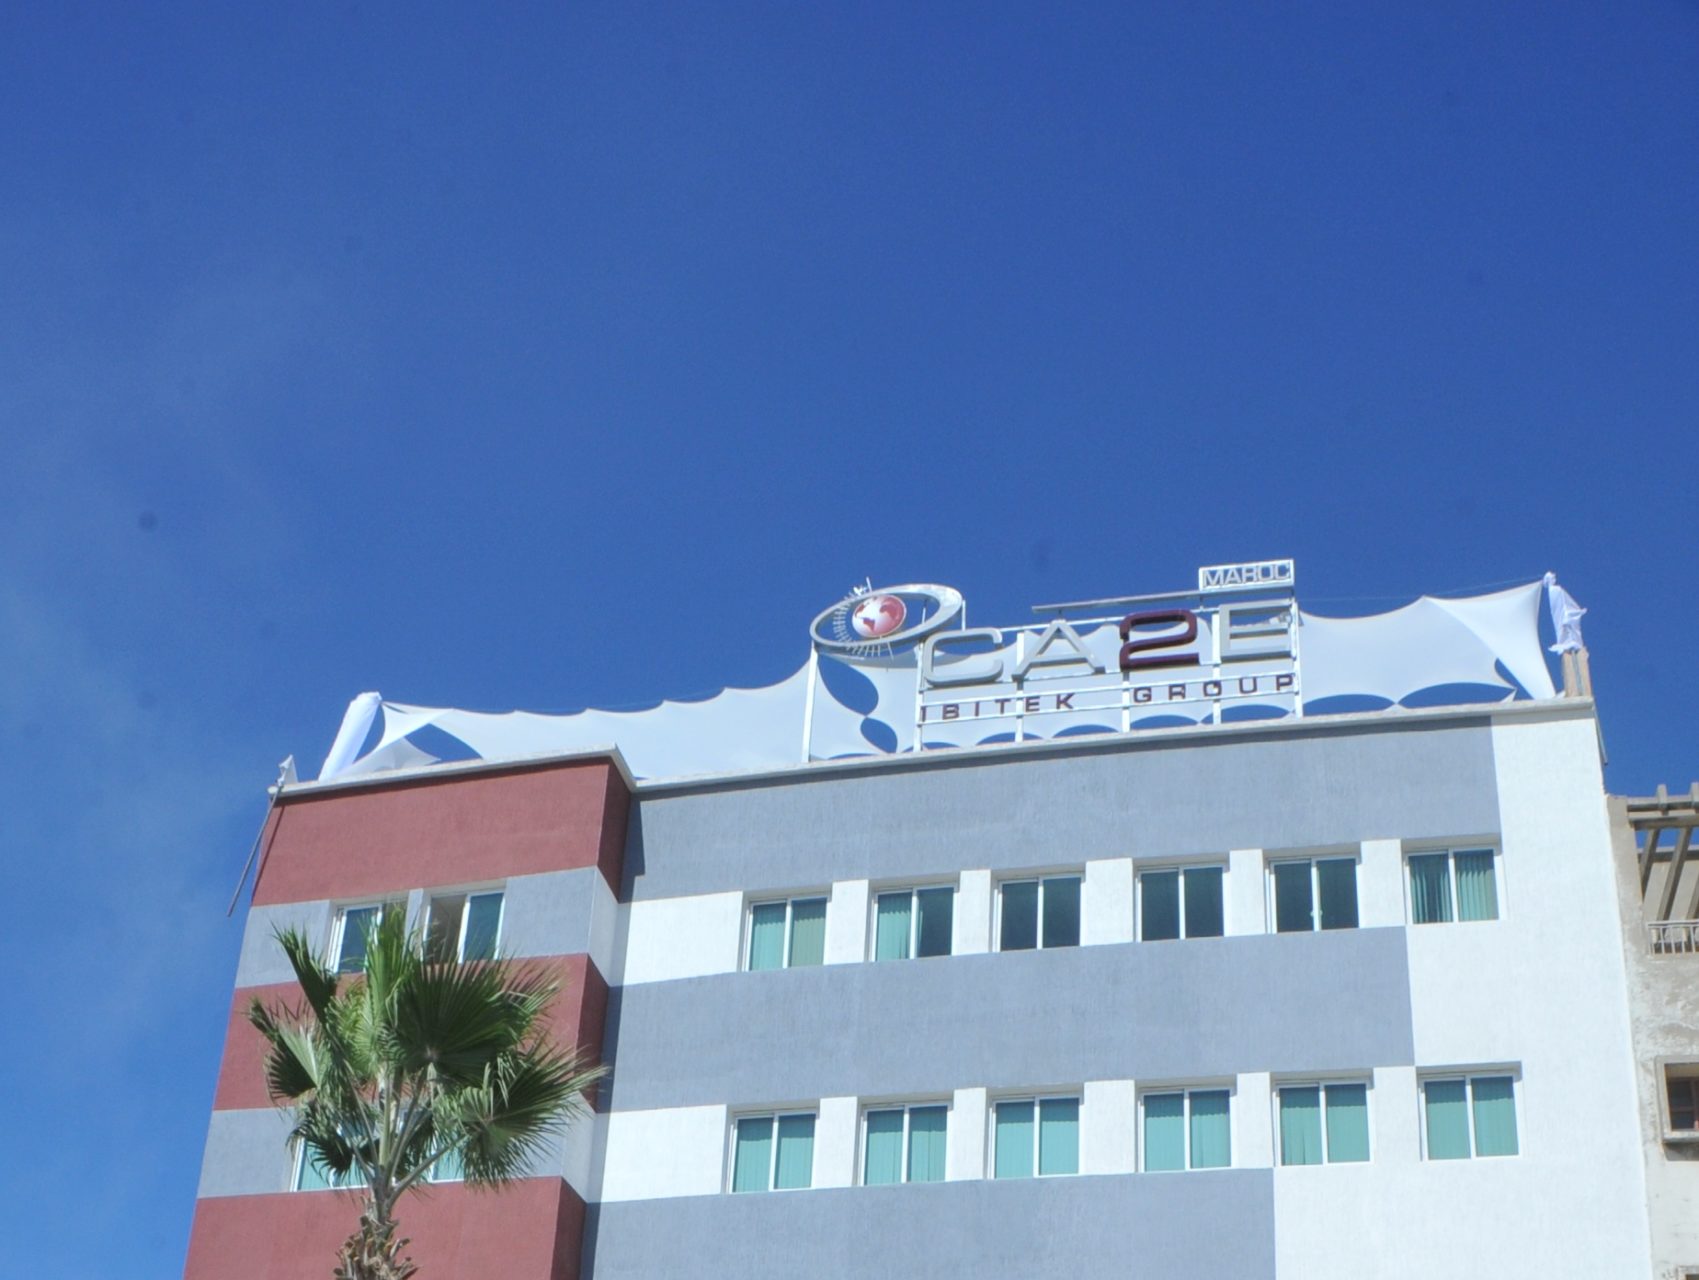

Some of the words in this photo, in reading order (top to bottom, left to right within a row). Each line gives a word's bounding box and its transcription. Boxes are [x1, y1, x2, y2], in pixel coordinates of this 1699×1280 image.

[1203, 564, 1291, 587] MAROC
[923, 600, 1293, 688] CA2E
[920, 692, 1076, 723] IBITEK
[1132, 673, 1294, 704] GROUP
